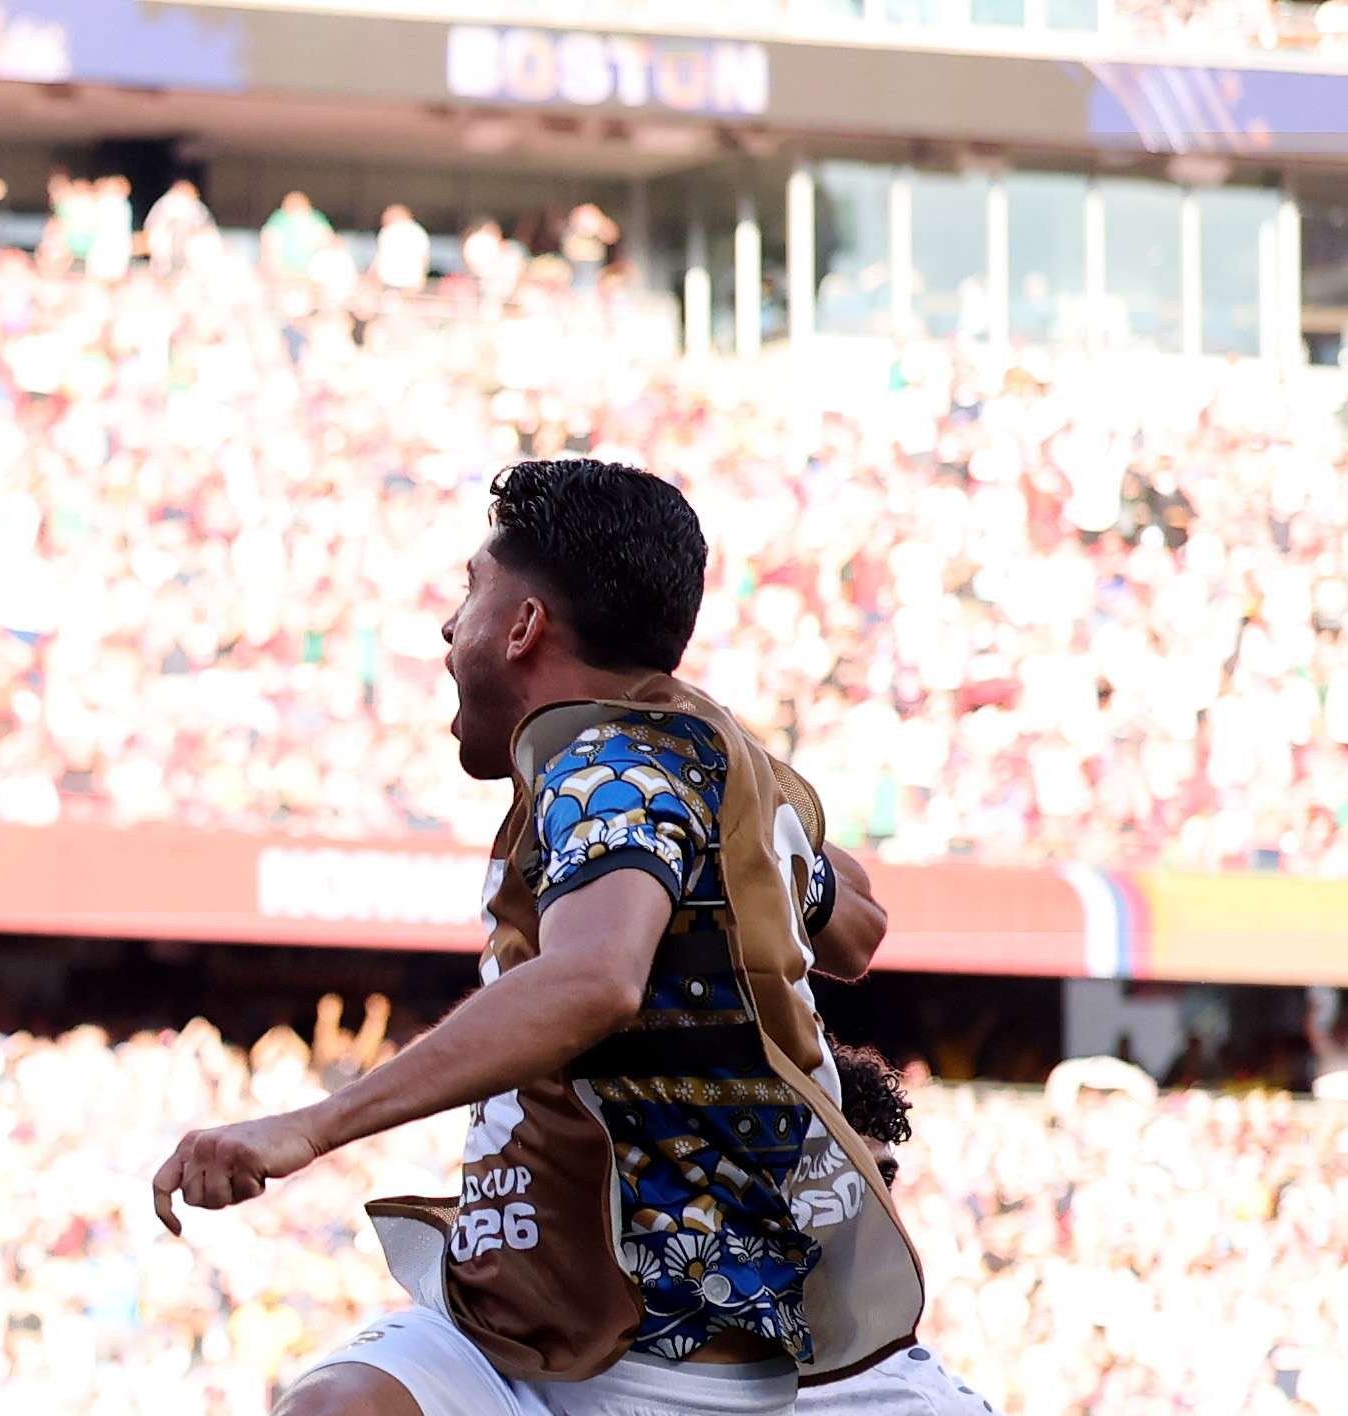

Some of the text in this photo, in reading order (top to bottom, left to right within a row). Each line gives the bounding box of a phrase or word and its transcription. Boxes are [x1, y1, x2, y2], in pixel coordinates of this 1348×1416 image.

[446, 27, 770, 114] BOSTON
[481, 1165, 533, 1200] CUP
[451, 1201, 539, 1263] 026
